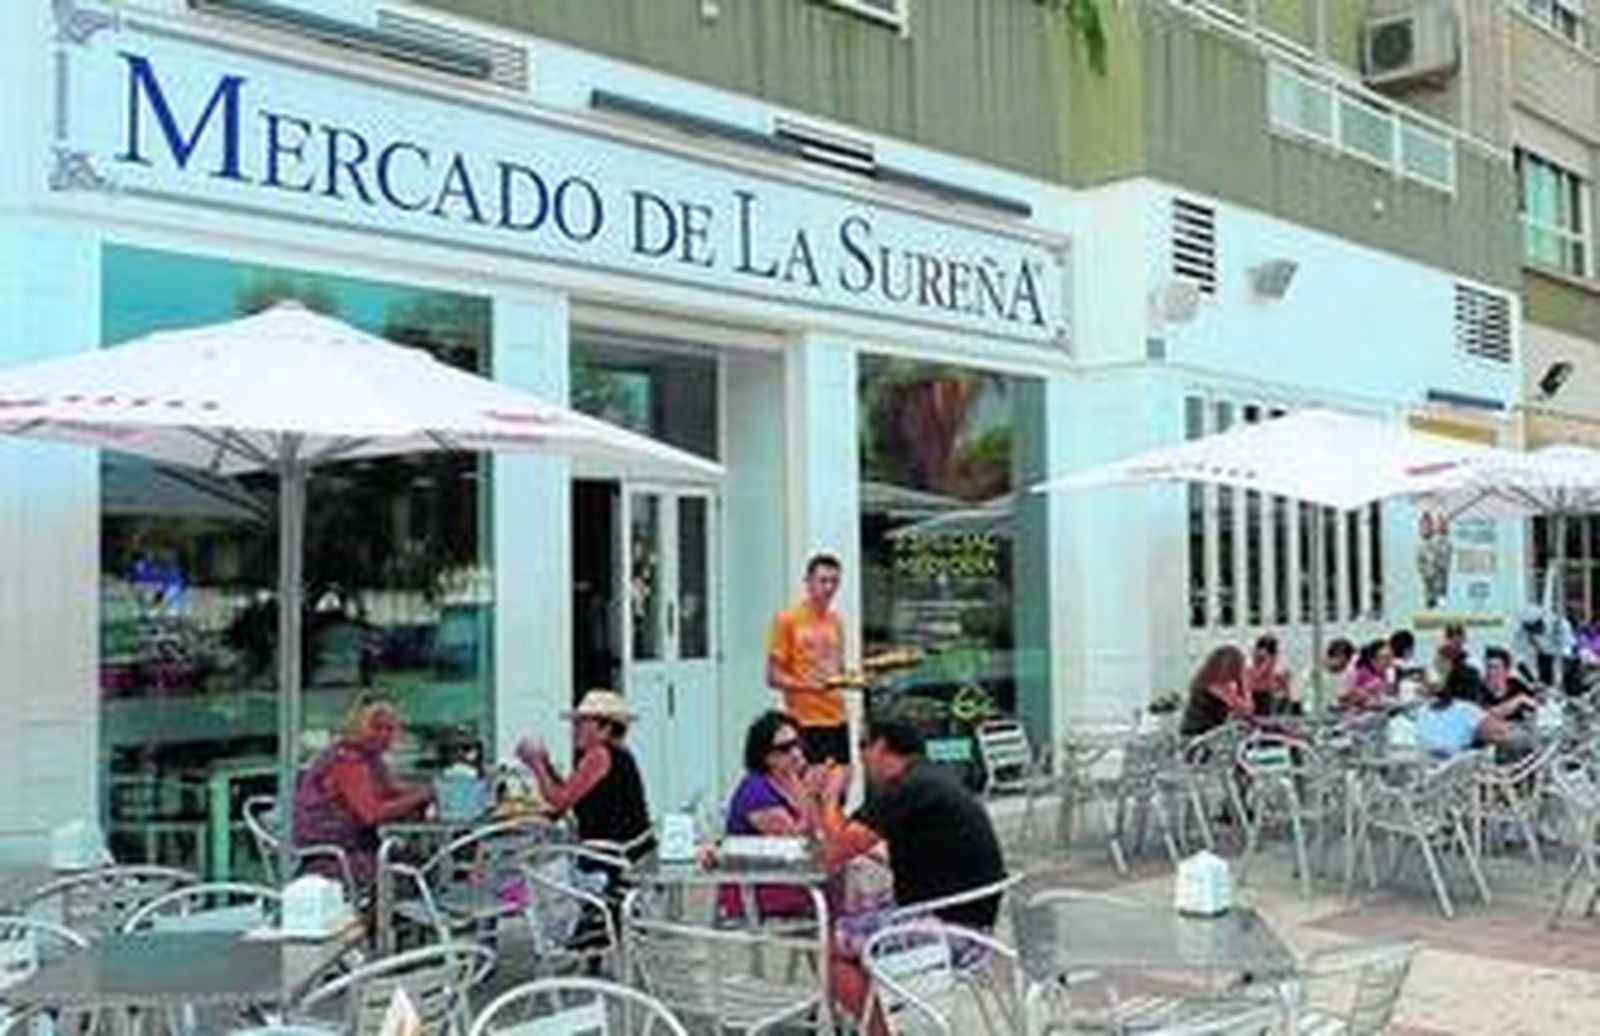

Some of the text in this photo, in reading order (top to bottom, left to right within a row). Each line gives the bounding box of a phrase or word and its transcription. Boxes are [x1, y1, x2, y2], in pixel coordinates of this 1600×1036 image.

[116, 50, 1046, 327] MERCADO DE LA SUREÑA
